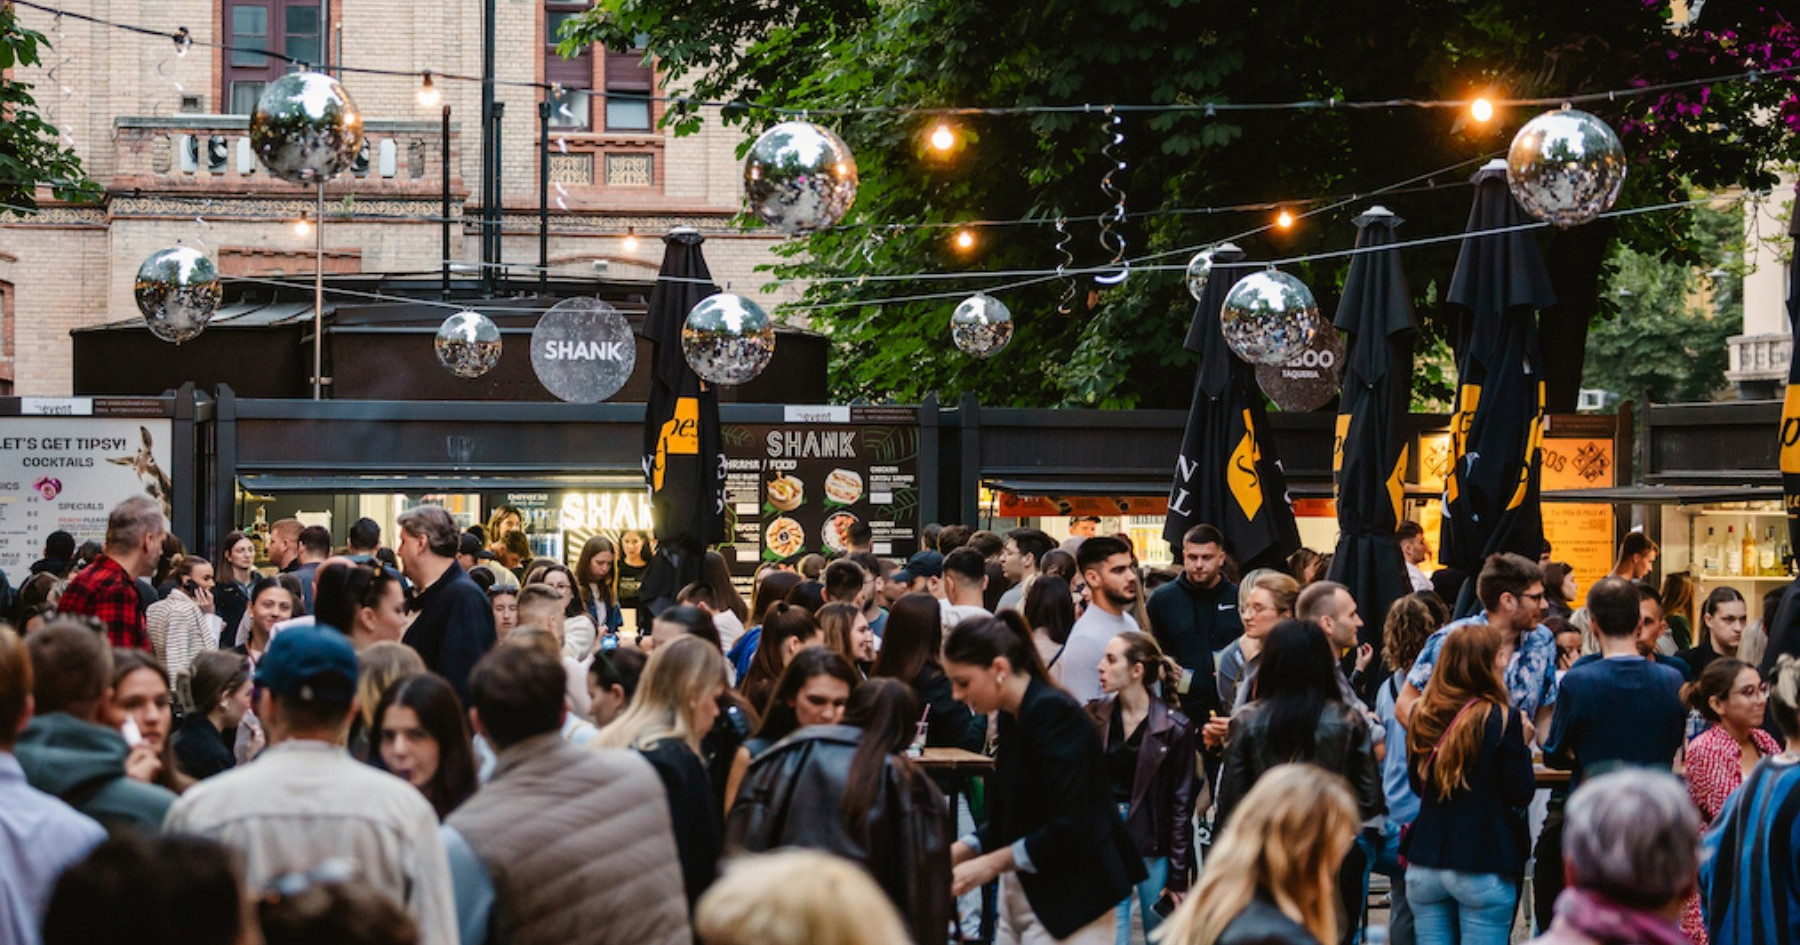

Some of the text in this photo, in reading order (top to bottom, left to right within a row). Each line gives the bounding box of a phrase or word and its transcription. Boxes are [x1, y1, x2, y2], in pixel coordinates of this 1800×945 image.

[544, 341, 623, 360] SHANK
[1287, 350, 1334, 368] BOO
[1282, 370, 1319, 379] TAQUERIA
[41, 438, 71, 449] GET
[76, 438, 126, 450] TIPSY!
[766, 430, 856, 458] SHANK
[23, 457, 93, 467] COCKTAILS
[769, 459, 797, 470] FOOD
[58, 503, 104, 511] SPECIALS
[562, 493, 654, 529] SHAN
